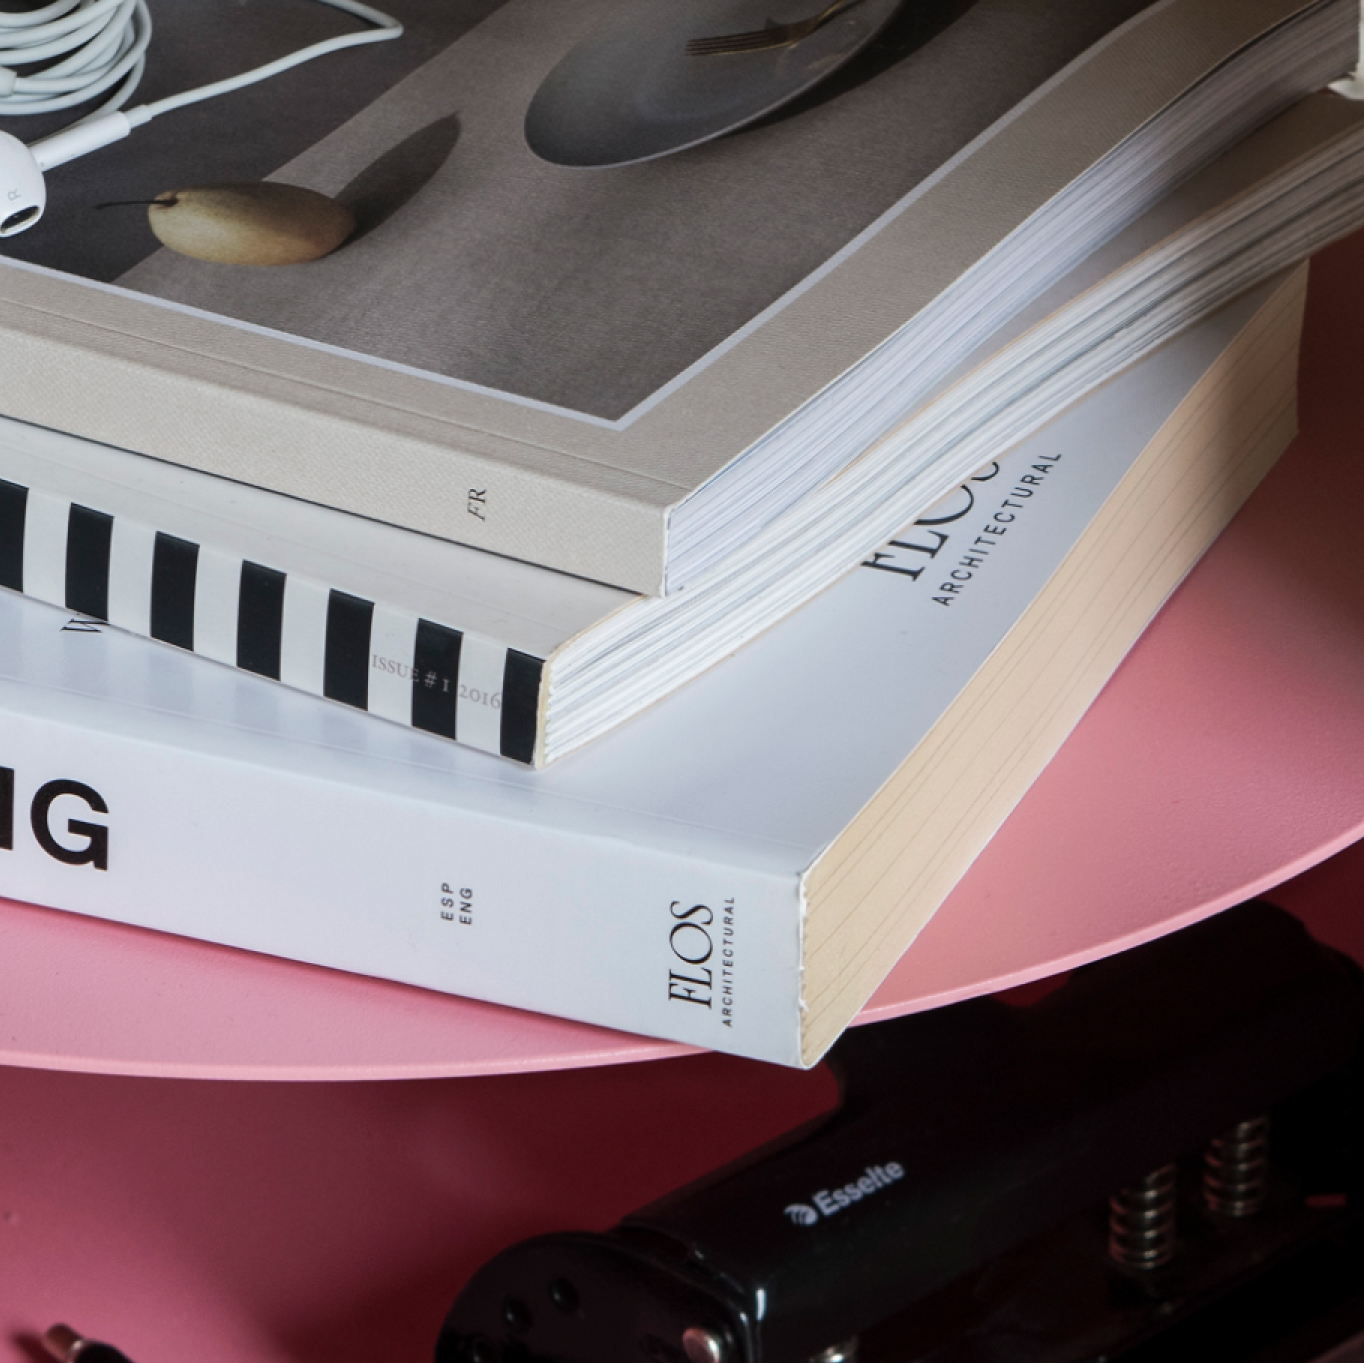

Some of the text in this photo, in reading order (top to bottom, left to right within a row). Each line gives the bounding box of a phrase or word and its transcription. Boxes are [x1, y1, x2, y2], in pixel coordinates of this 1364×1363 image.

[467, 488, 487, 522] FR
[932, 454, 1062, 607] ARCHITECTURAL
[372, 654, 419, 682] ISSUE
[459, 684, 502, 709] 2016
[441, 883, 454, 922] ESP
[460, 887, 473, 926] ENG
[668, 900, 714, 1010] FLOS
[722, 897, 735, 1028] ARCHITECTURAL
[813, 1162, 905, 1216] Esselte
